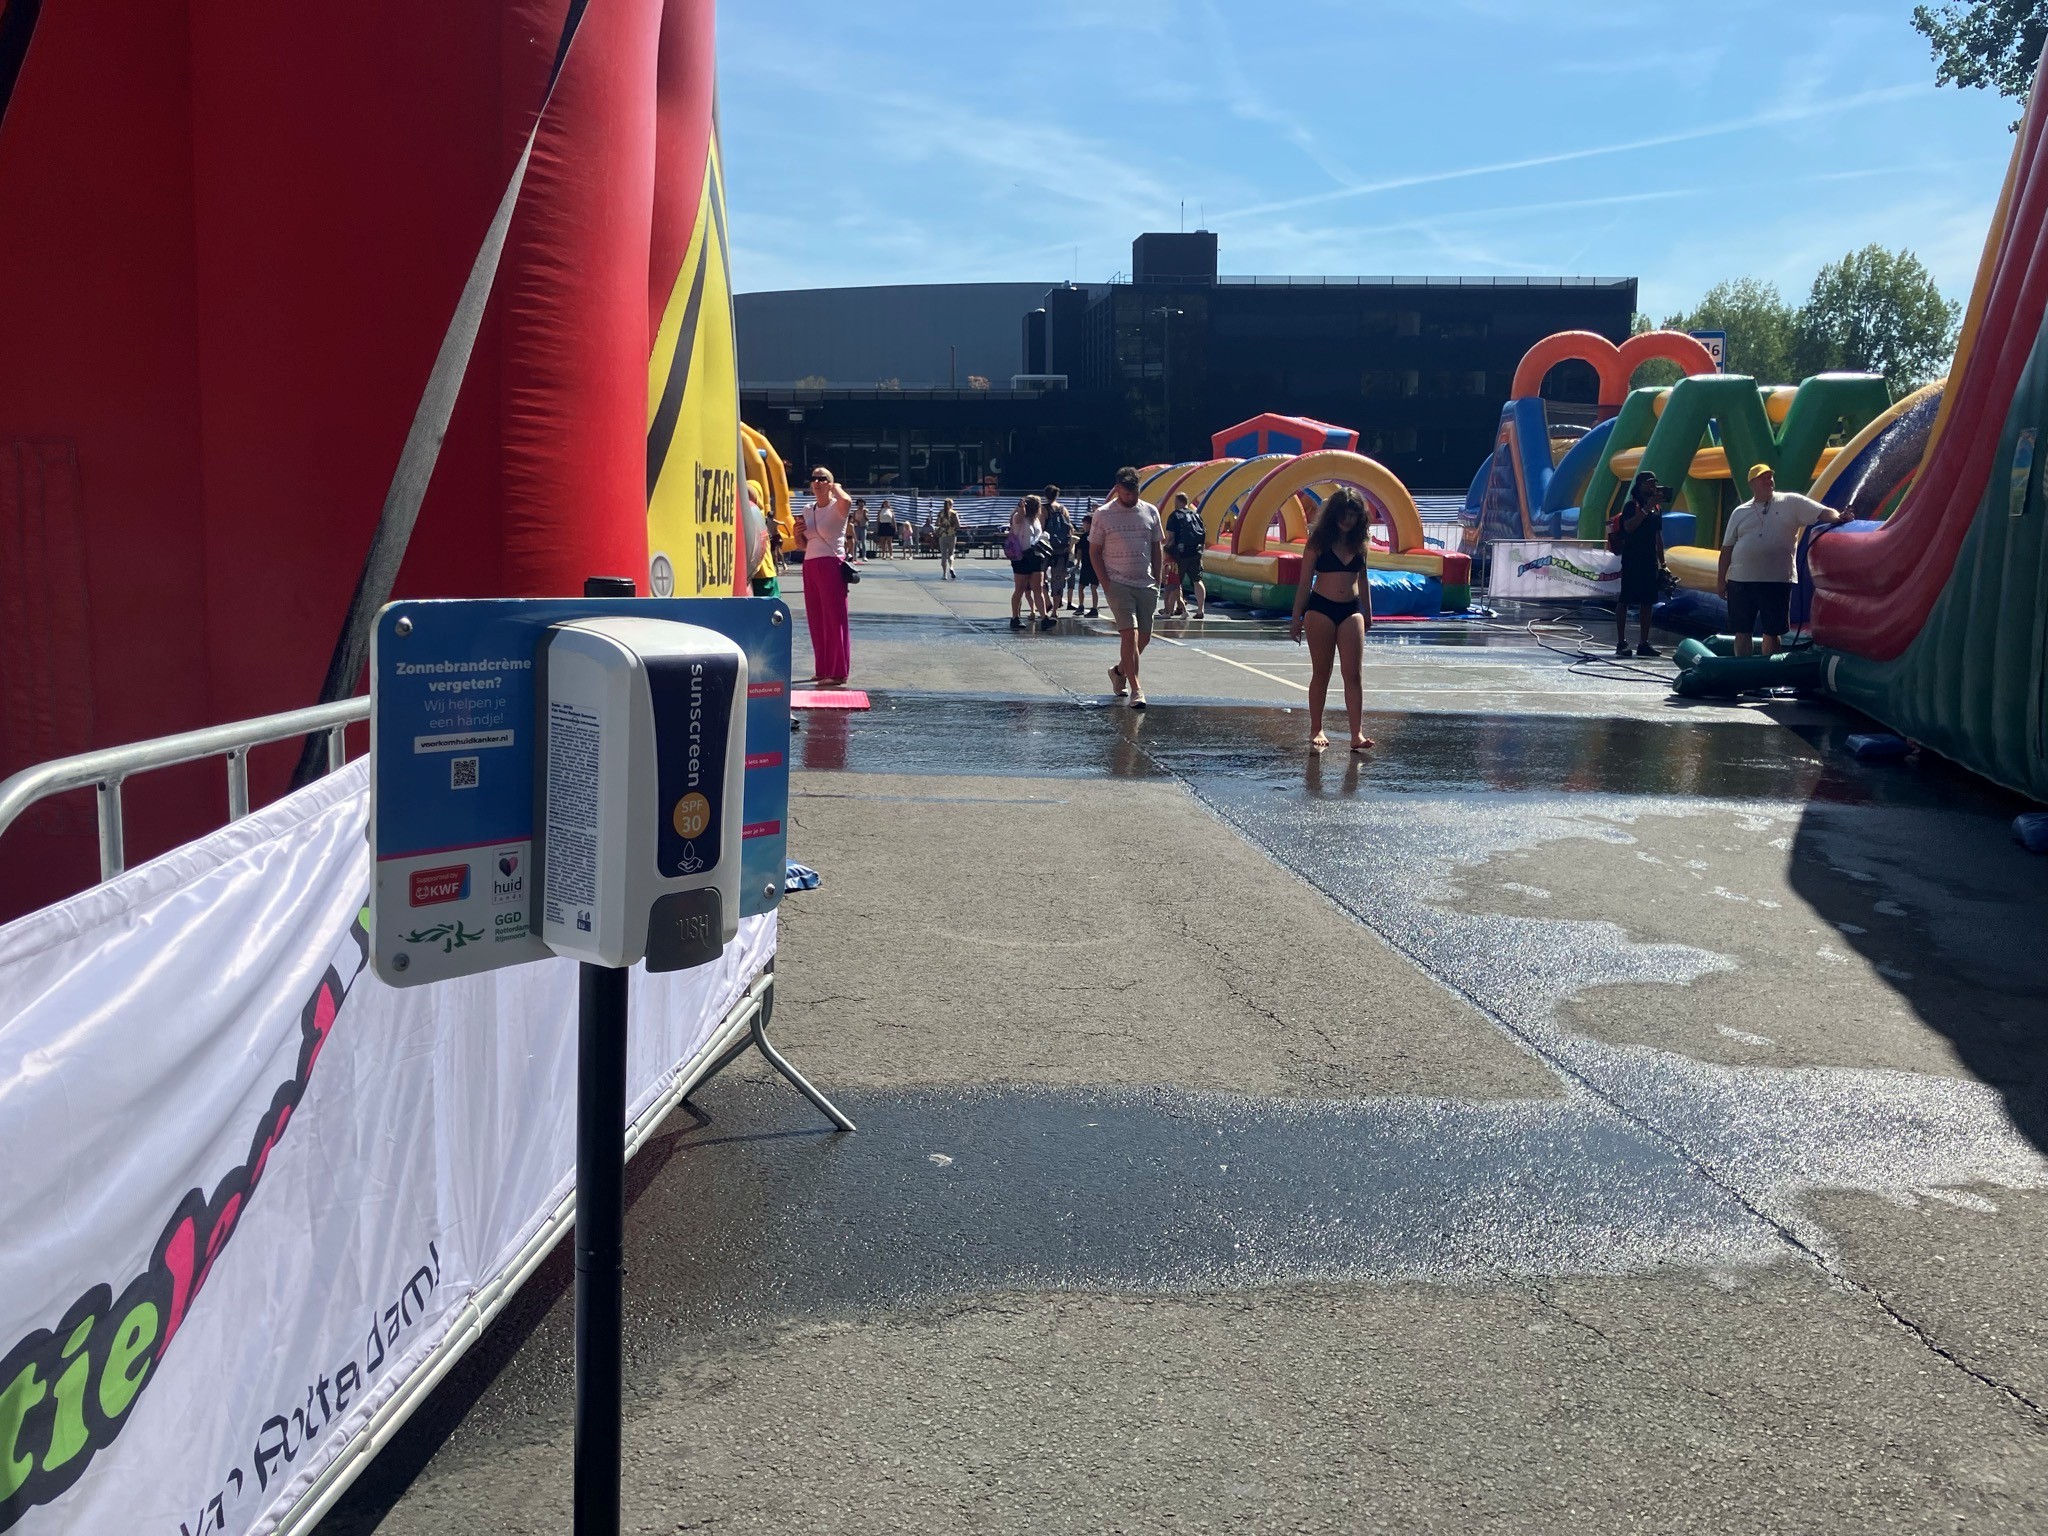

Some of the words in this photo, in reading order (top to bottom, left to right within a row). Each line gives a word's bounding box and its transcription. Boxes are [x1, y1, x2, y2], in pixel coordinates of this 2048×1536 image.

[1711, 344, 1720, 357] 6
[396, 657, 532, 675] Zonnebrandcrème
[428, 677, 502, 693] vergeten?
[424, 699, 446, 714] Wij
[449, 698, 492, 711] helpen
[494, 696, 506, 710] je
[430, 718, 454, 729] een
[457, 713, 504, 727] handje!
[688, 664, 703, 787] sunscreen
[420, 735, 509, 748] voorkomhuidkanker.nl
[681, 799, 703, 814] SPF
[682, 815, 702, 833] 30
[416, 873, 450, 884] Supported
[450, 872, 458, 880] by
[494, 877, 522, 894] huid
[430, 882, 460, 897] KWF
[495, 912, 522, 926] GGD
[495, 932, 526, 943] Rijnmond
